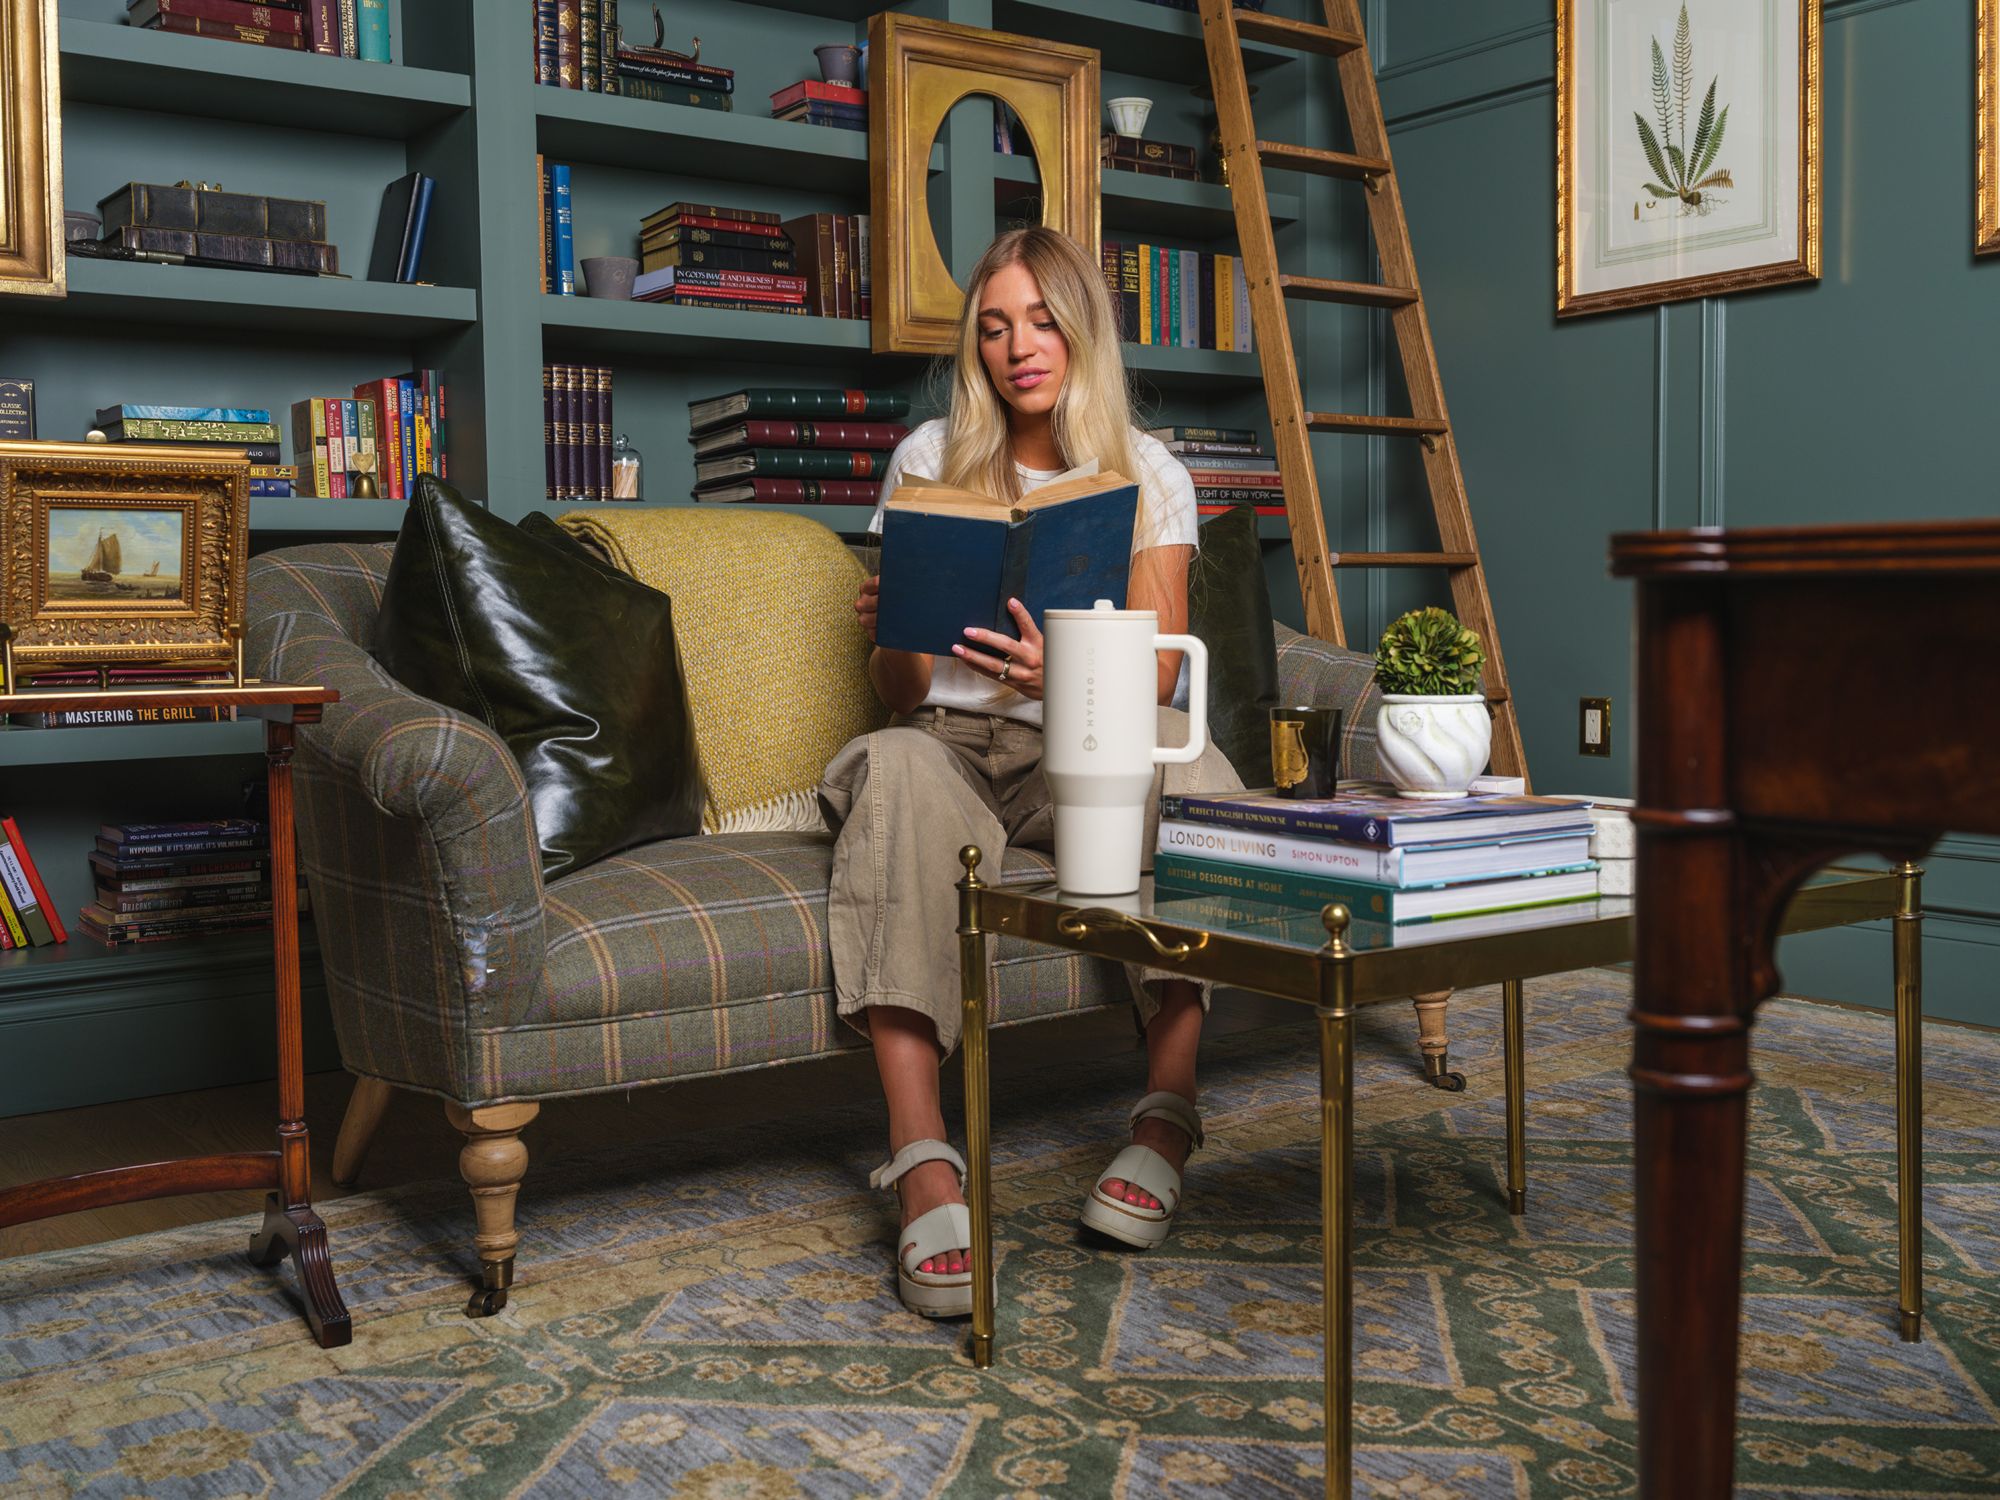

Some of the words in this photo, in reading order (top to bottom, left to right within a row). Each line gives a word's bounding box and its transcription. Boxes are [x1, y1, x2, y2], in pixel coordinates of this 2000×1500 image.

[706, 273, 726, 281] IMAGE
[727, 274, 741, 282] AND
[742, 276, 770, 284] LIKENESS
[318, 463, 326, 497] HOBBIT
[1197, 489, 1218, 498] LIGHT
[1220, 490, 1230, 498] OF
[1232, 490, 1249, 499] NEW
[1250, 491, 1270, 499] YORK
[65, 709, 134, 724] MASTERING
[136, 708, 159, 721] THE
[163, 706, 196, 720] GRILL
[1189, 806, 1214, 816] PERFECT
[1216, 808, 1246, 821] ENGLISH
[1246, 811, 1285, 825] TOWNHOUSE
[130, 845, 162, 855] HYPPONEN
[174, 844, 183, 852] IT'S
[217, 839, 253, 848] VULNERABLE
[1169, 829, 1226, 850] LONDON
[1230, 839, 1276, 858] LIVING
[1292, 849, 1322, 862] SIMON
[1325, 855, 1359, 867] UPTON
[1168, 867, 1196, 880] BRITISH
[1199, 872, 1243, 887] DESIGNERS
[1246, 880, 1255, 889] AT
[1258, 883, 1284, 894] HOME
[122, 902, 152, 912] DRAGONS
